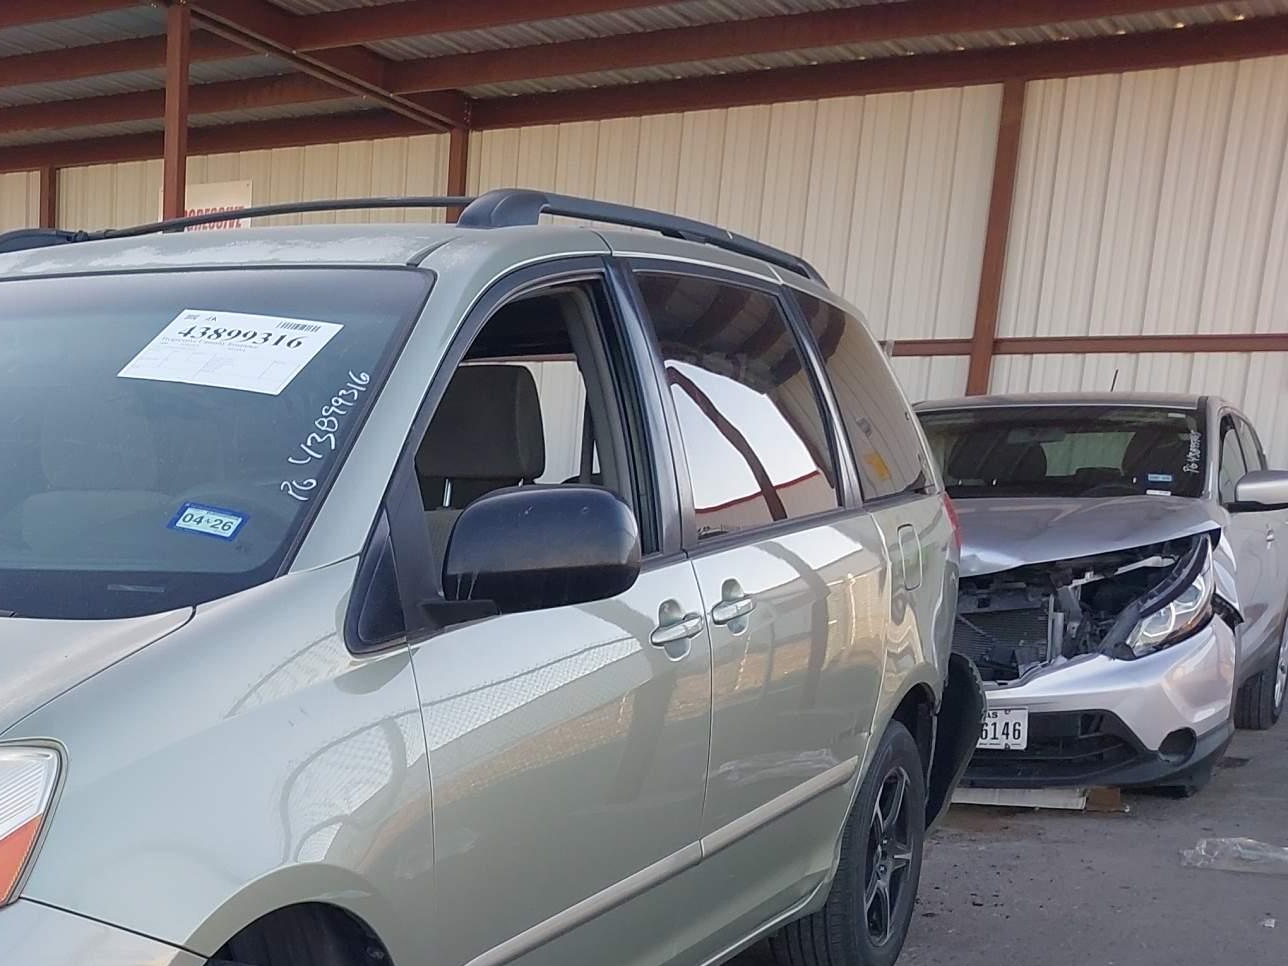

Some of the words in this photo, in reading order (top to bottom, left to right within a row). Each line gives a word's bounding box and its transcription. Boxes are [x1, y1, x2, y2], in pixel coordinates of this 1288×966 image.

[178, 325, 307, 349] 43899316
[288, 370, 370, 464] 43899316
[182, 513, 204, 525] 04
[210, 519, 234, 531] 26
[981, 721, 1021, 741] 6146
